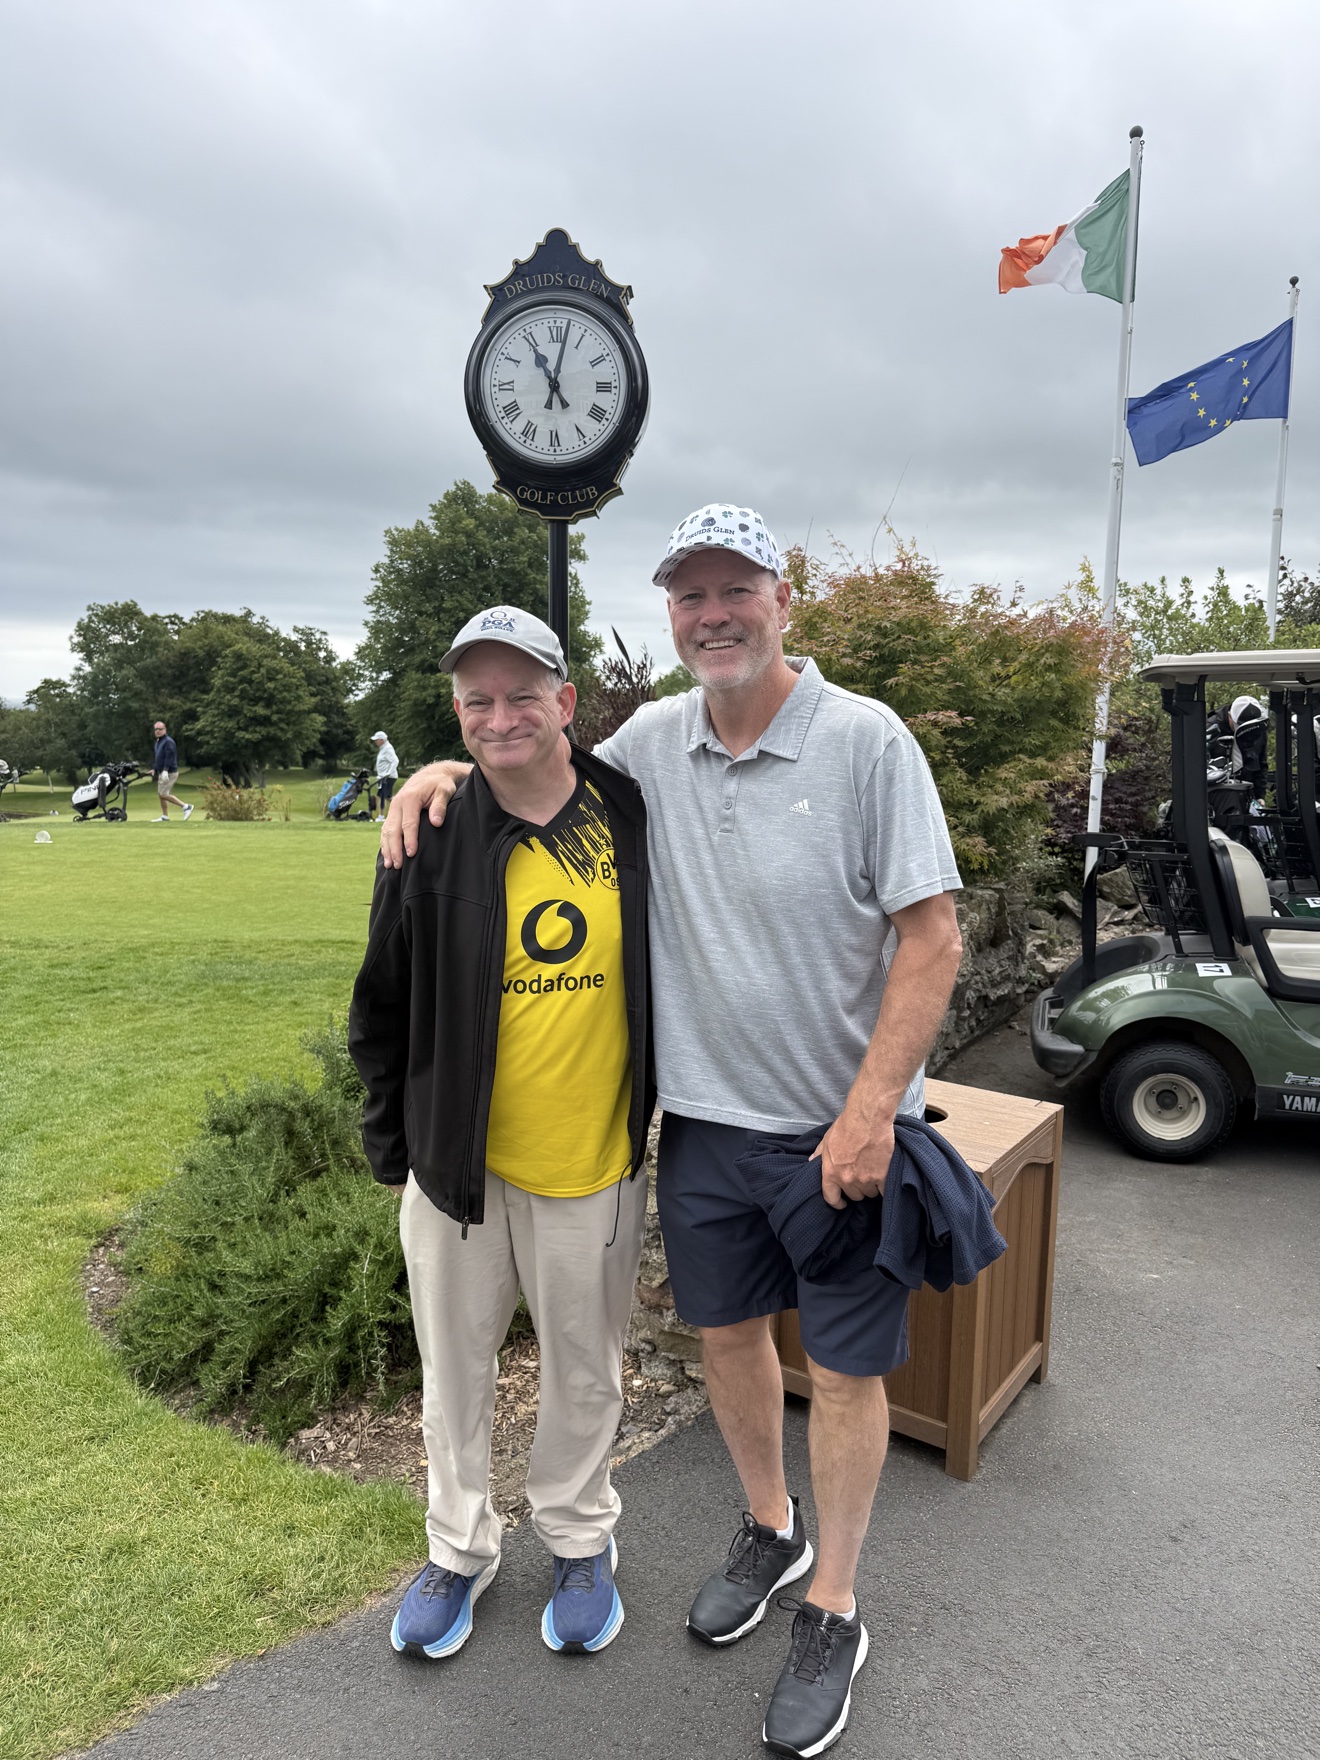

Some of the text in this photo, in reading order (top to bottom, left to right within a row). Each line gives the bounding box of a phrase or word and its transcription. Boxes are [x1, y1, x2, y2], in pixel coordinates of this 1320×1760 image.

[503, 272, 611, 299] DRUIDS GLEN
[521, 331, 540, 352] XI
[547, 325, 563, 343] XII
[503, 352, 522, 368] X
[588, 352, 607, 369] II
[498, 379, 515, 393] IX
[595, 380, 612, 394] III
[502, 399, 523, 425] VIII
[586, 402, 608, 425] IIII
[520, 419, 538, 443] VII
[548, 428, 561, 448] VI
[574, 423, 589, 442] V
[516, 485, 599, 505] GOLF CLUB
[480, 619, 515, 629] PGA
[789, 806, 812, 816] adidas
[1202, 964, 1225, 974] 17
[502, 972, 605, 995] vodafone
